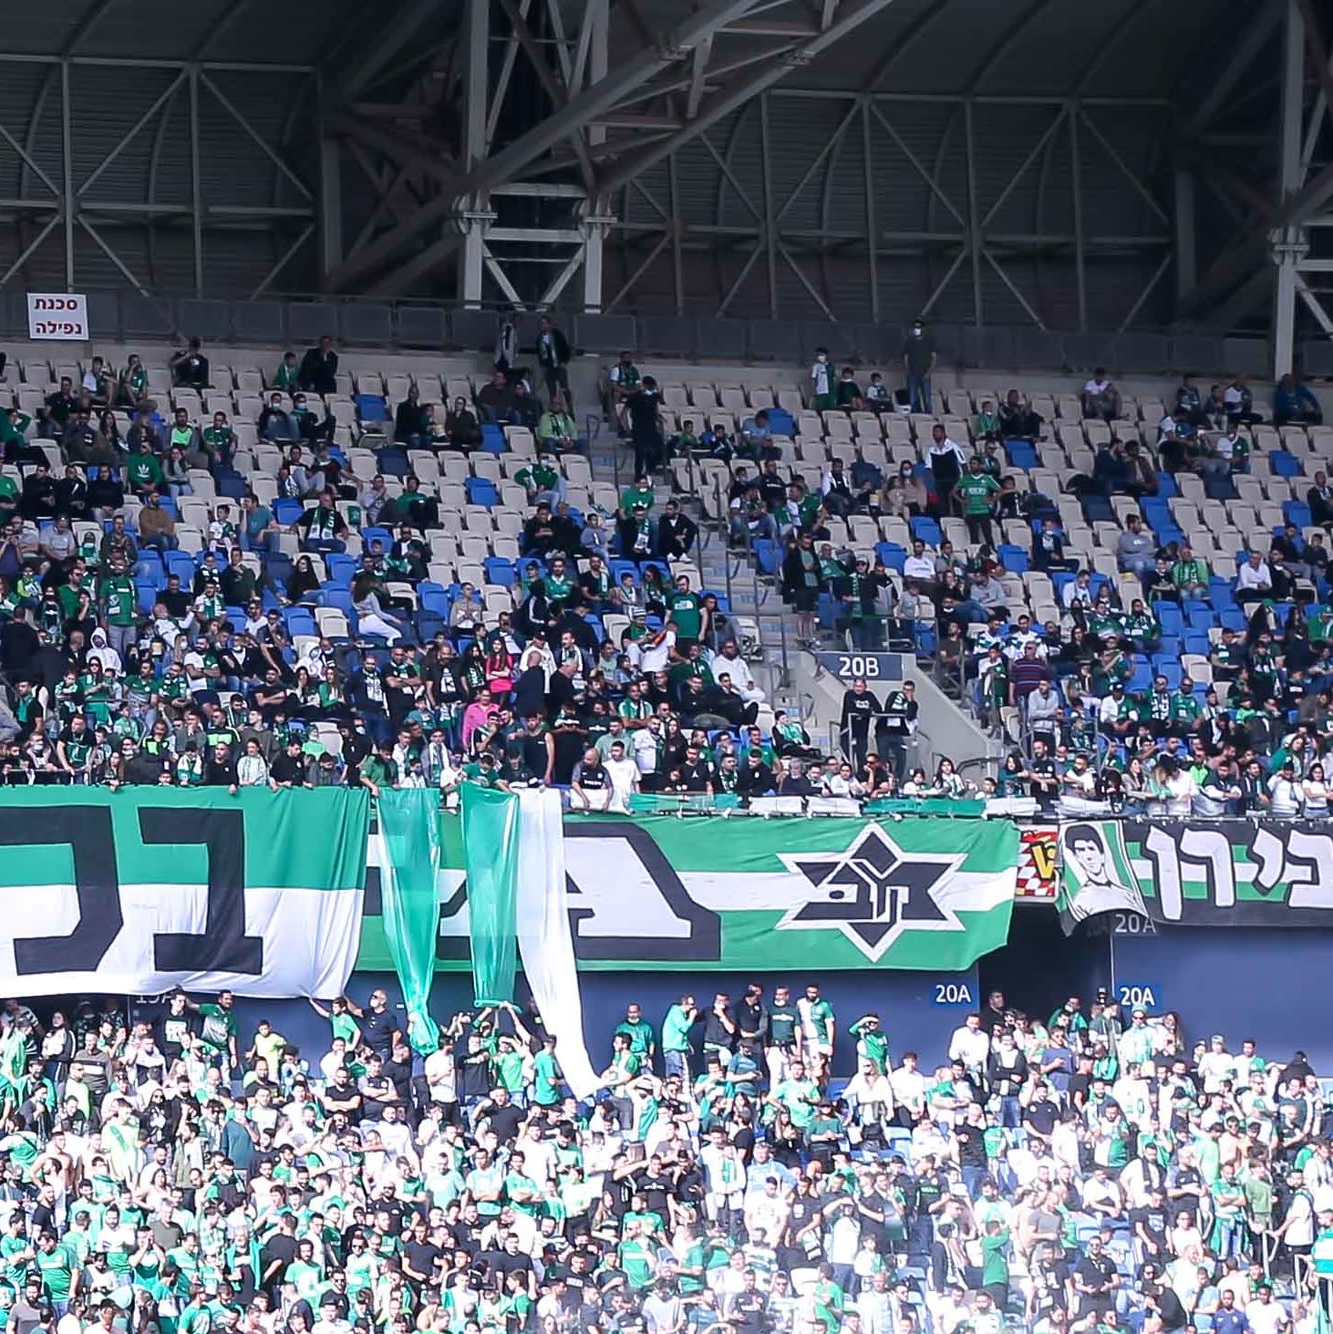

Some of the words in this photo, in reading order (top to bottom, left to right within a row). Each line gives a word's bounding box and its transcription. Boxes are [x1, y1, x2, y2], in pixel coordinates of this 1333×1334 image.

[34, 298, 78, 310] סכנת
[35, 321, 82, 335] נפילה
[838, 656, 880, 677] 20B
[1114, 913, 1157, 934] 20A
[935, 984, 972, 1003] 20A
[1119, 987, 1156, 1006] 20A
